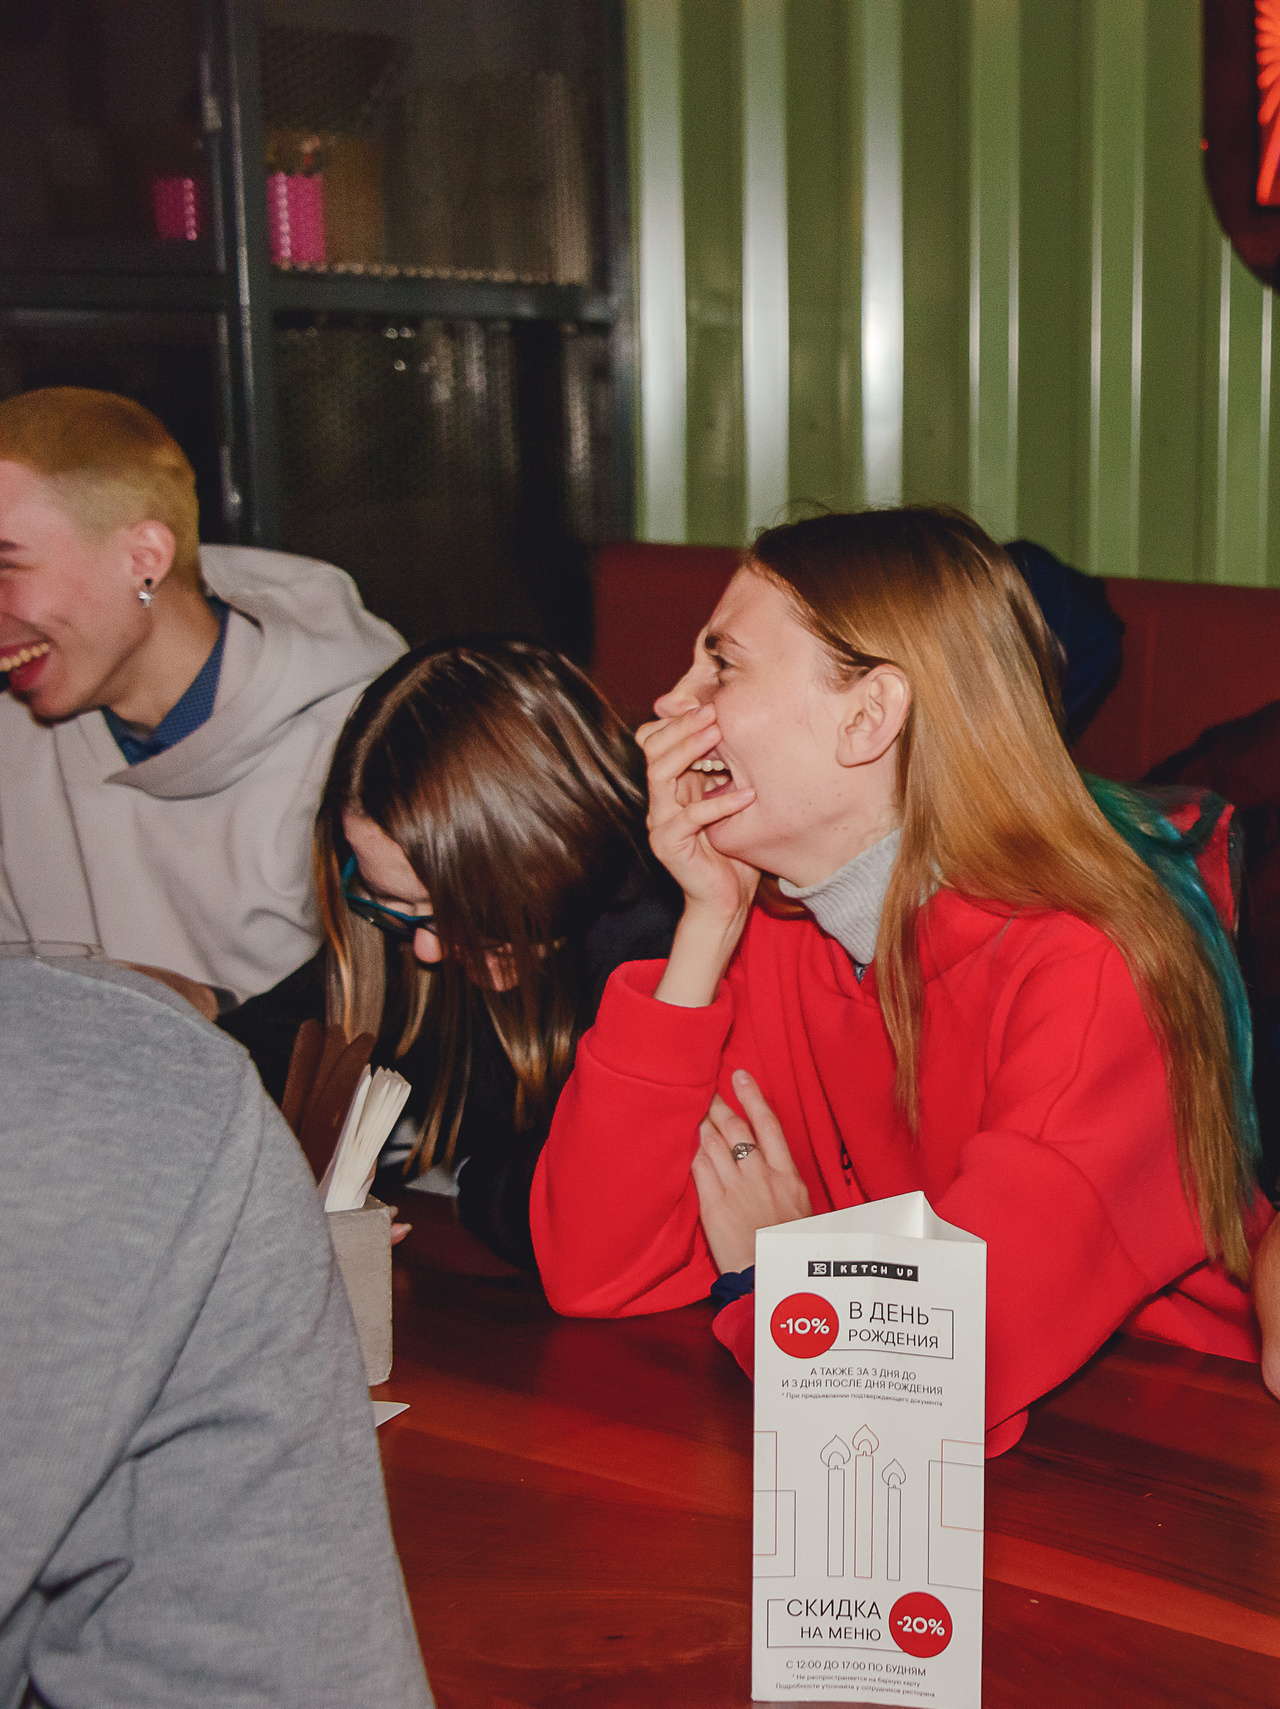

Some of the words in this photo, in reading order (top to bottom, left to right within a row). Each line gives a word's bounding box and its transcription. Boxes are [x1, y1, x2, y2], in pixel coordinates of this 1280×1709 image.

[840, 1264, 888, 1275] KETCH
[896, 1267, 914, 1278] UP
[849, 1301, 863, 1320] В
[869, 1301, 930, 1326] ДЕНЬ
[780, 1317, 830, 1335] -10%
[848, 1328, 939, 1349] РОЖДЕНИЯ
[810, 1367, 818, 1376] А
[820, 1366, 854, 1376] ТАКЖЕ
[856, 1366, 870, 1376] ЗА
[871, 1367, 878, 1376] 3
[879, 1368, 900, 1379] ДНЯ
[901, 1370, 917, 1381] ДО
[781, 1379, 789, 1388] И
[791, 1379, 798, 1388] 3
[799, 1379, 822, 1389] ДНЯ
[825, 1379, 862, 1388] ПОСЛЕ
[864, 1379, 886, 1389] ДНЯ
[888, 1381, 943, 1396] РОЖДЕНИЯ
[786, 1598, 882, 1621] СКИДКА
[800, 1626, 823, 1639] НА
[828, 1626, 882, 1642] МЕНЮ
[896, 1615, 946, 1637] -20%
[785, 1660, 794, 1669] С
[823, 1660, 840, 1670] ДО
[868, 1662, 884, 1672] ПО
[885, 1663, 927, 1677] БУДНЯМ
